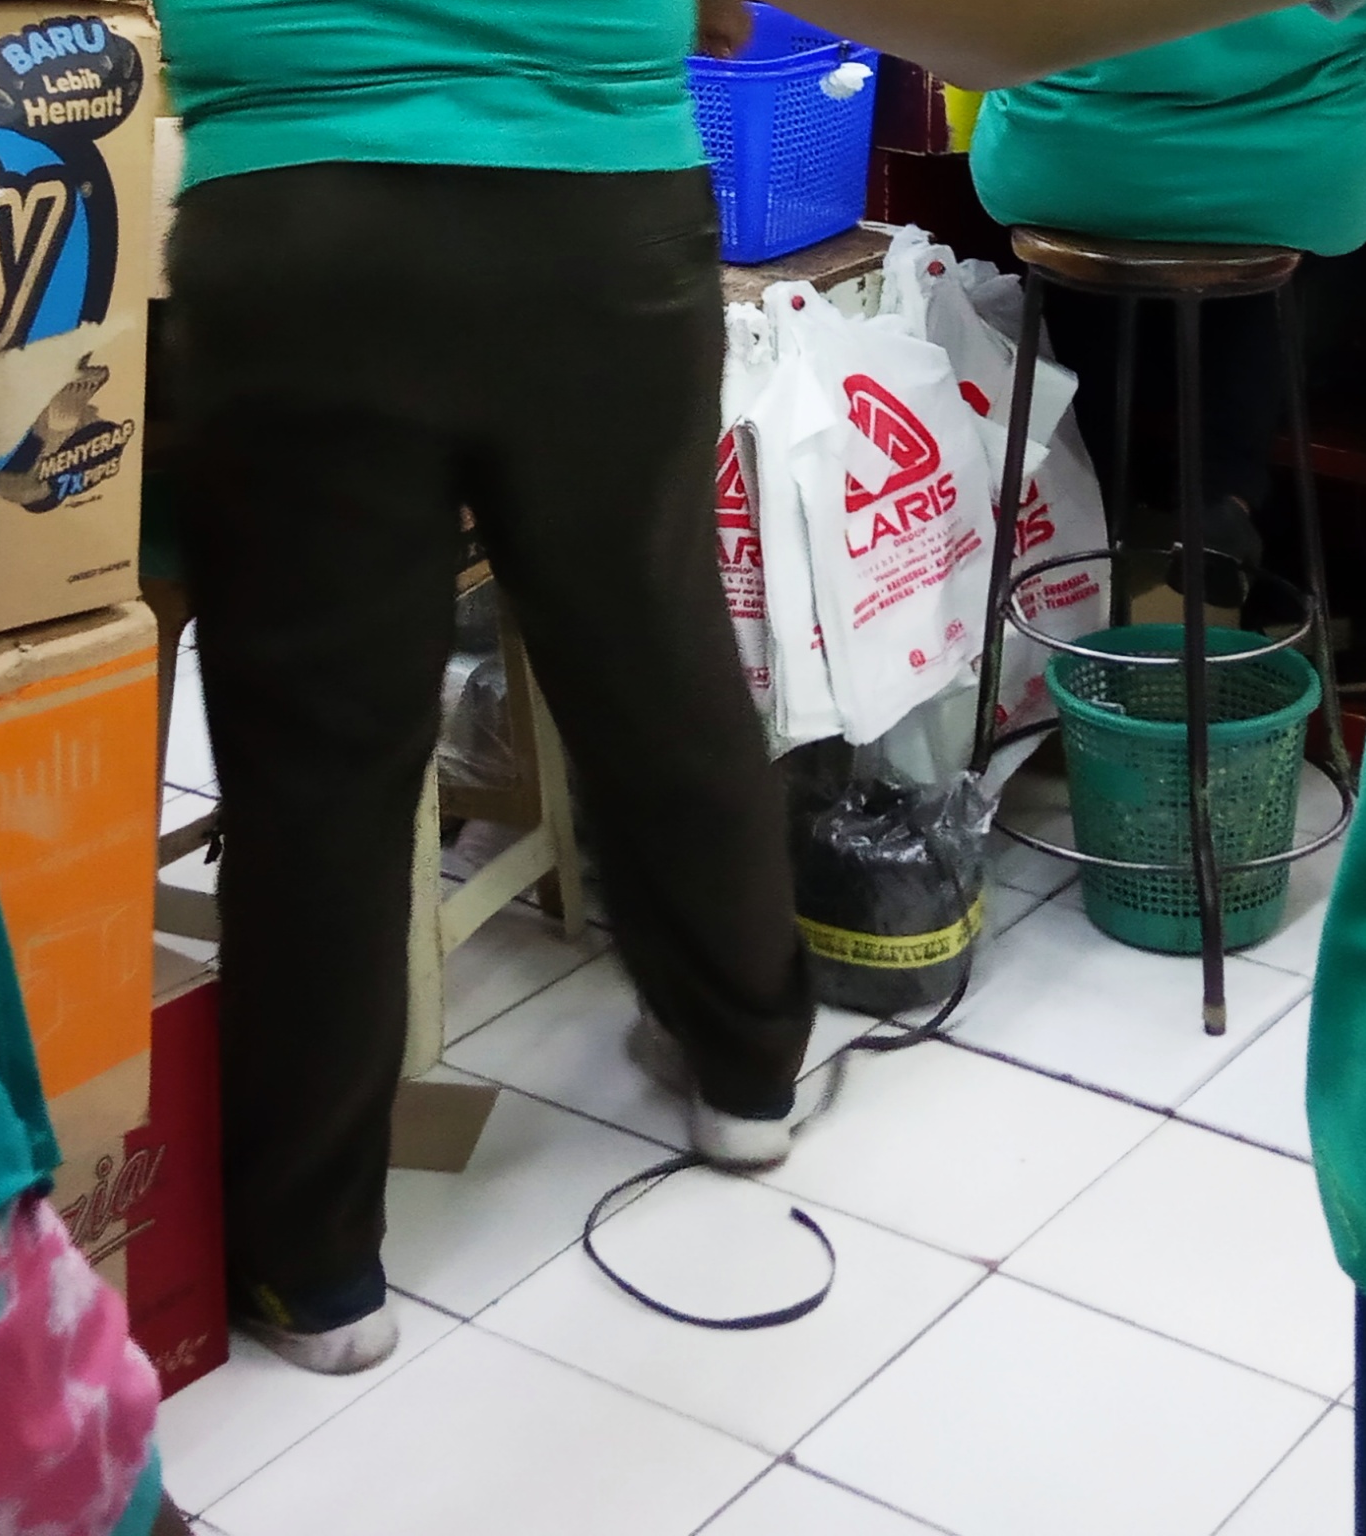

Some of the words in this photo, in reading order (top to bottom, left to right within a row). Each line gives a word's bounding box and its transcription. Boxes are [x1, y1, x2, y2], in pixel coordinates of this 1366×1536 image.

[1, 22, 106, 76] BARU
[41, 67, 102, 95] Lebih
[22, 86, 123, 128] Hemat!
[37, 419, 135, 482] MENYERAP
[56, 471, 84, 501] 7X
[844, 471, 958, 559] LARIS
